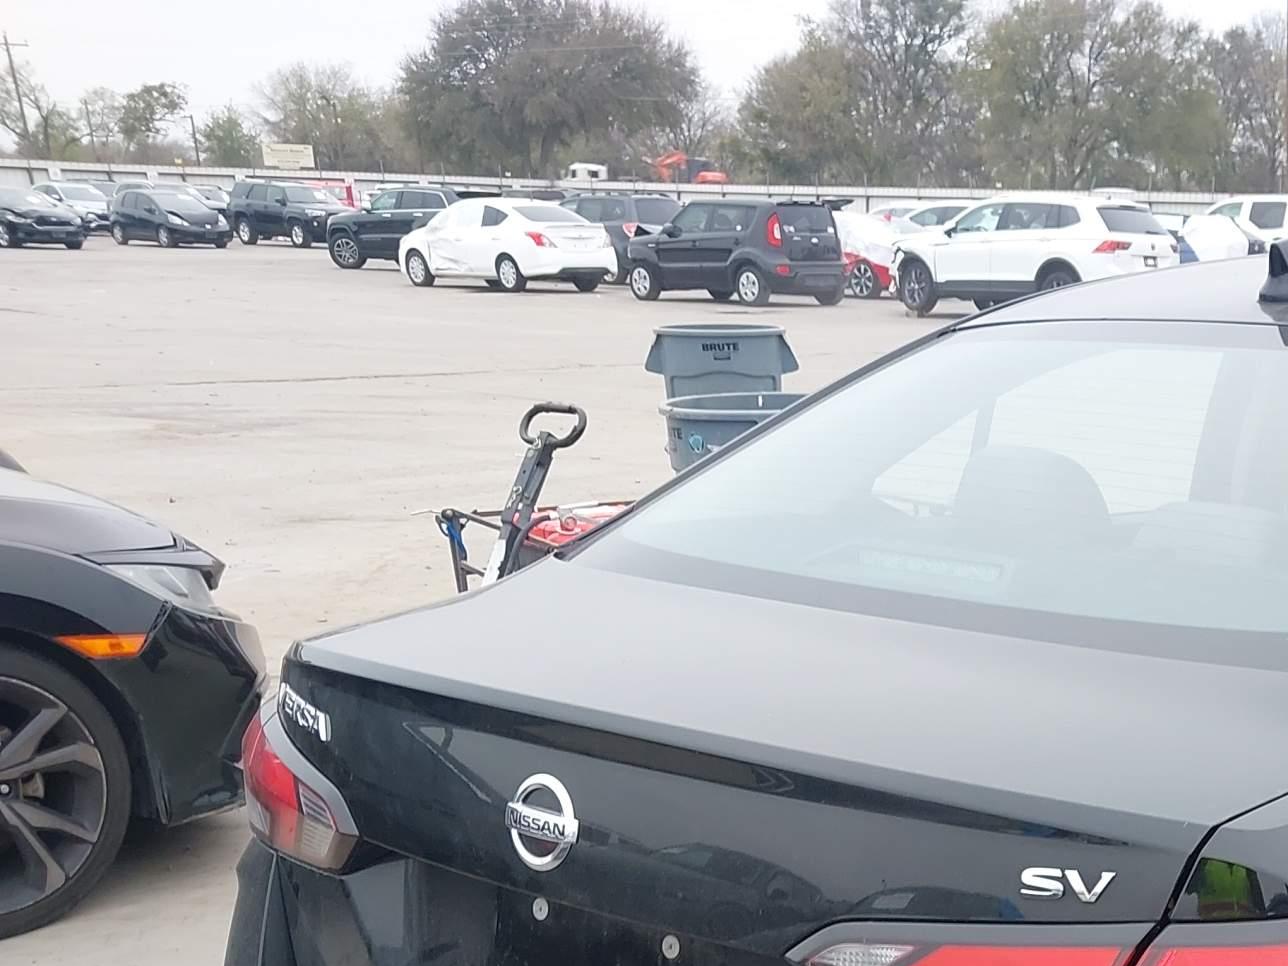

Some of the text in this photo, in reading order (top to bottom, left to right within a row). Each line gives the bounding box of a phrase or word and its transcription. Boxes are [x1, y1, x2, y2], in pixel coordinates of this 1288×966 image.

[701, 342, 740, 352] BRUTE
[508, 808, 566, 837] NISSAN
[1020, 867, 1117, 903] SV
